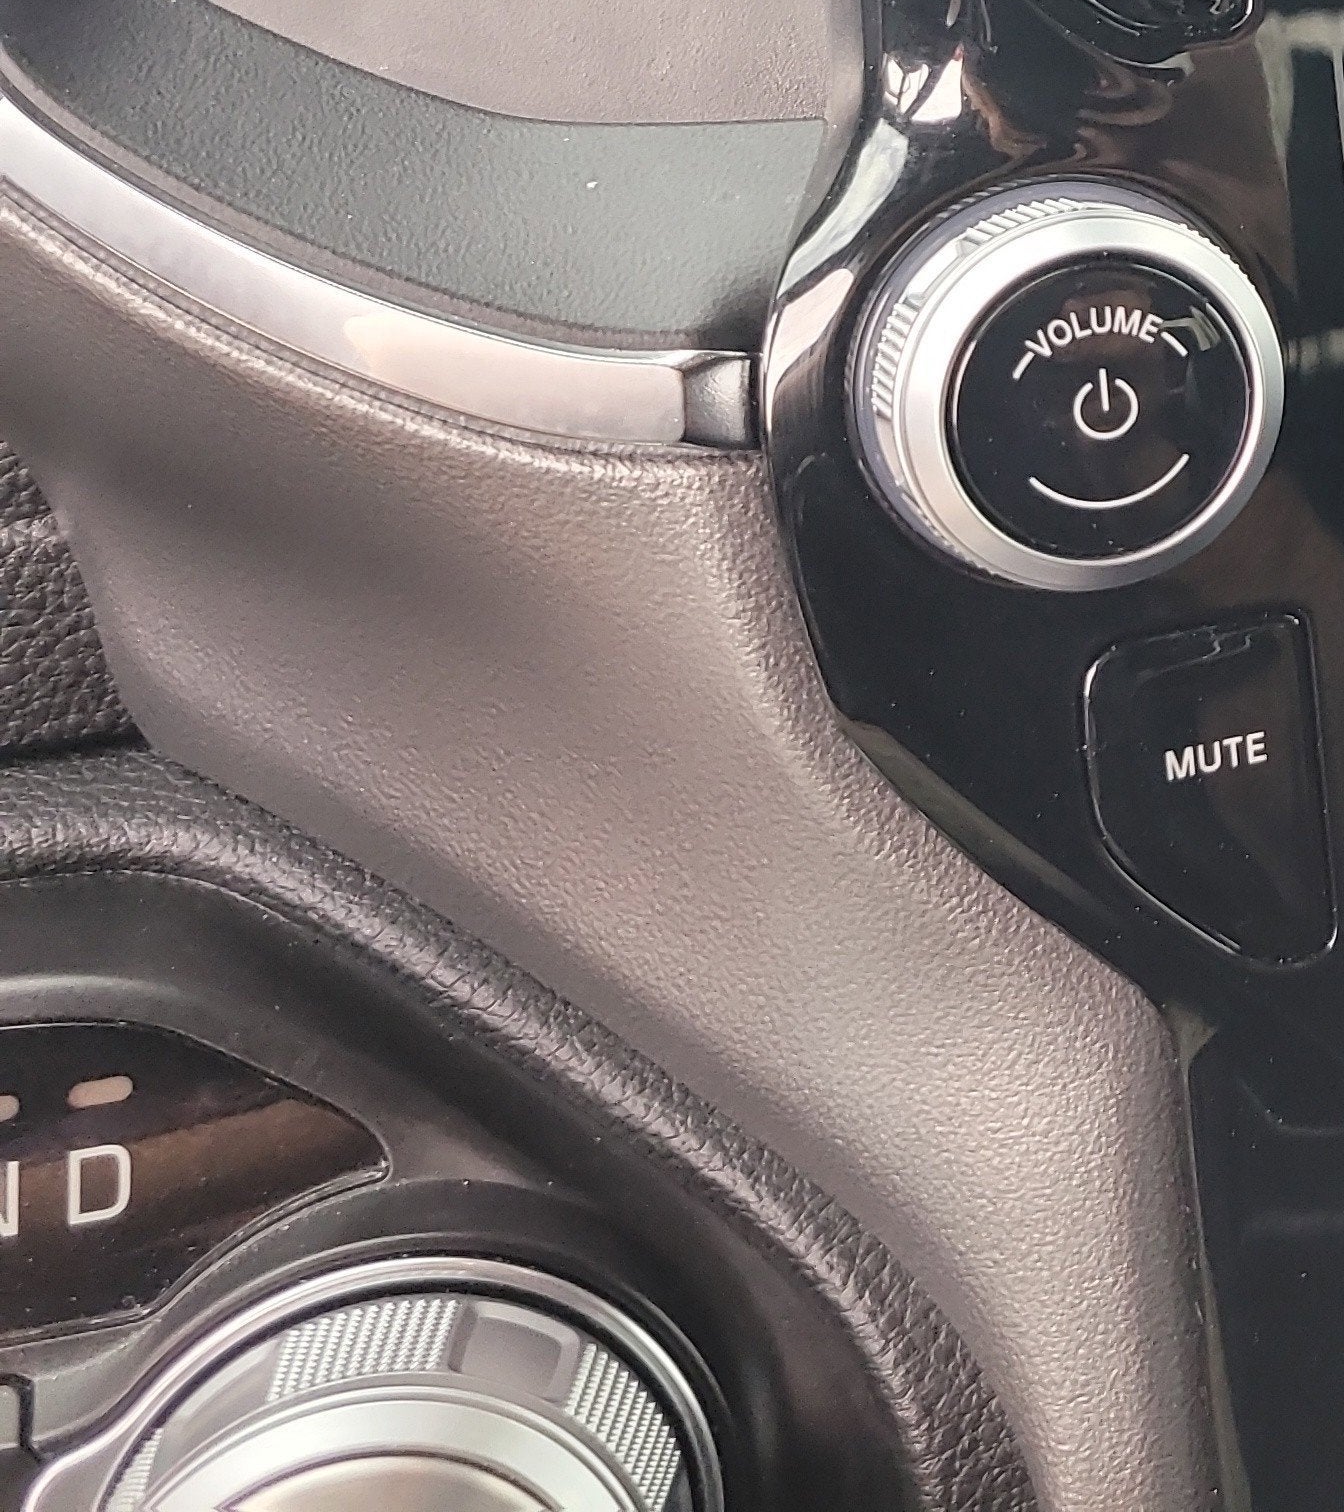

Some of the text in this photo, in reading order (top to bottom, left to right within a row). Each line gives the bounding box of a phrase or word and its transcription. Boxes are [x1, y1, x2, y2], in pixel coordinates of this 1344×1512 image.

[1025, 305, 1162, 359] VOLUME
[1164, 729, 1268, 782] MUTE
[67, 1144, 132, 1226] D
